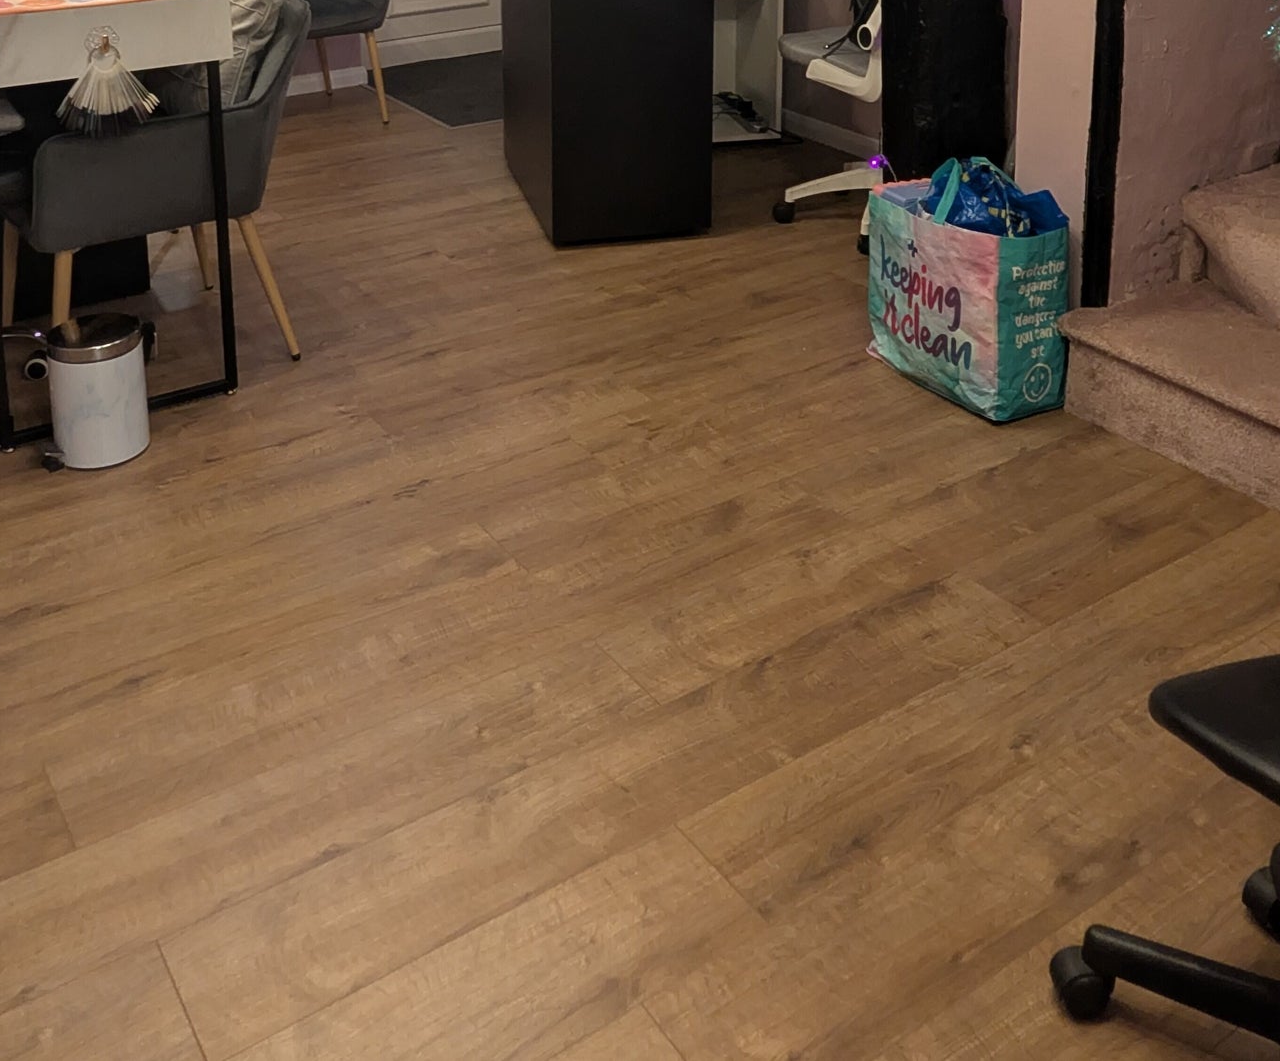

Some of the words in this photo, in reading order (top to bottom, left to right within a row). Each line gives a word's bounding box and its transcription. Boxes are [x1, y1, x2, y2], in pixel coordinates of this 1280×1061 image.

[1011, 260, 1065, 281] Protection
[880, 234, 961, 332] keeping
[1018, 276, 1058, 297] against
[1028, 294, 1046, 308] the
[883, 289, 899, 335] it
[901, 302, 972, 370] clean
[1015, 311, 1056, 327] dangers
[1015, 331, 1034, 349] you
